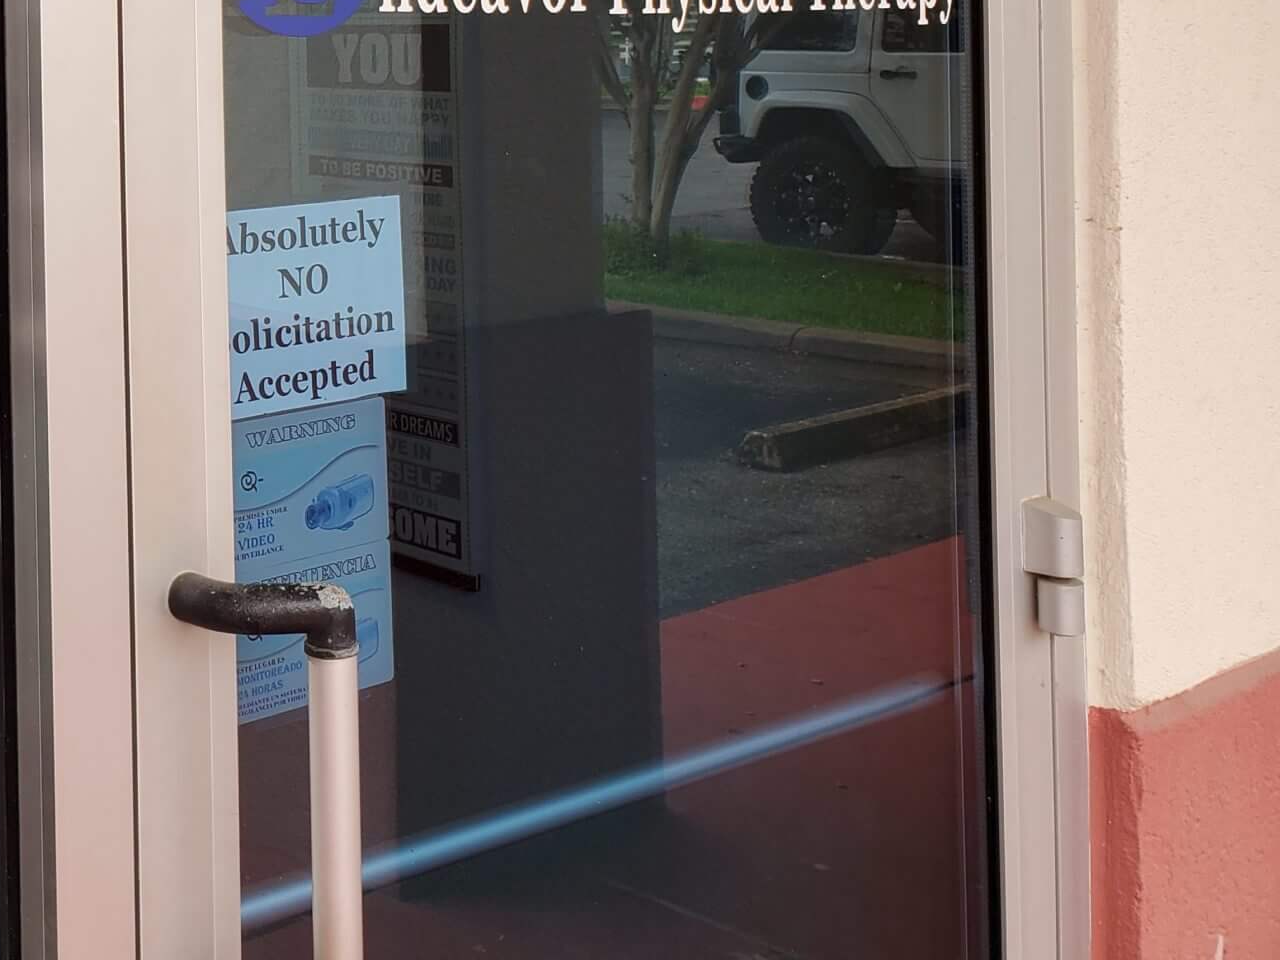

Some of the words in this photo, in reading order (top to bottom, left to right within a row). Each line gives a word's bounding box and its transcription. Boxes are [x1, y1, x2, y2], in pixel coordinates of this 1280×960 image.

[331, 32, 422, 85] YOU
[366, 162, 443, 184] POSITIVE
[277, 264, 328, 299] NO
[229, 306, 395, 355] olicitation
[234, 349, 377, 404] Accepted
[245, 413, 357, 448] WARNING
[401, 414, 453, 442] DREAMS
[257, 516, 274, 529] HR
[238, 533, 275, 551] VIDEO
